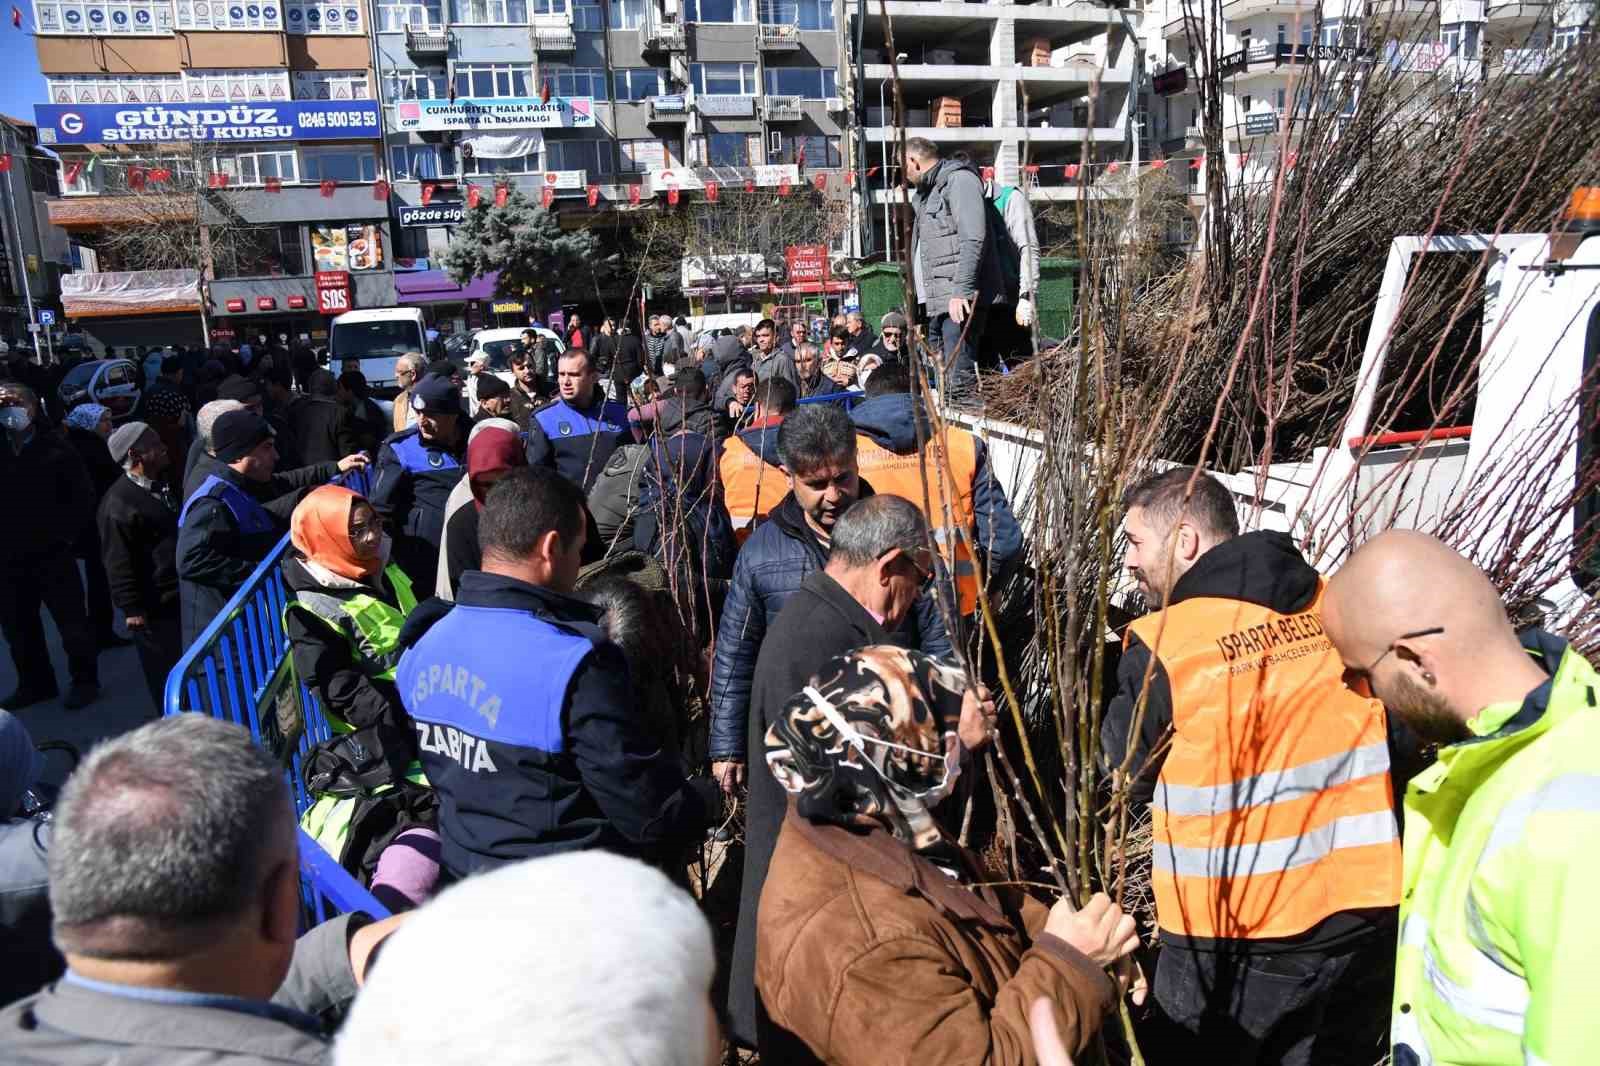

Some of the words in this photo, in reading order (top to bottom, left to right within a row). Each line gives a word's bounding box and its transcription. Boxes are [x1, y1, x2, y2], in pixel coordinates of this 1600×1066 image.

[115, 105, 278, 126] GÜNDÜZ
[496, 104, 523, 113] HALK
[298, 112, 326, 128] 0246
[327, 112, 348, 127] 500
[349, 111, 363, 126] 52
[364, 111, 376, 126] 53
[443, 117, 481, 125] ISPARTA
[102, 125, 207, 141] SÜRÜCÜ
[212, 125, 293, 139] KURSU
[403, 209, 442, 224] gözde
[793, 259, 822, 269] ÖZLEM
[791, 268, 823, 278] MARKET
[321, 288, 347, 309] SOS
[42, 312, 51, 322] P
[1215, 623, 1281, 662] ISPARTA
[411, 663, 502, 731] ISPARTA
[416, 721, 498, 773] ZABITA
